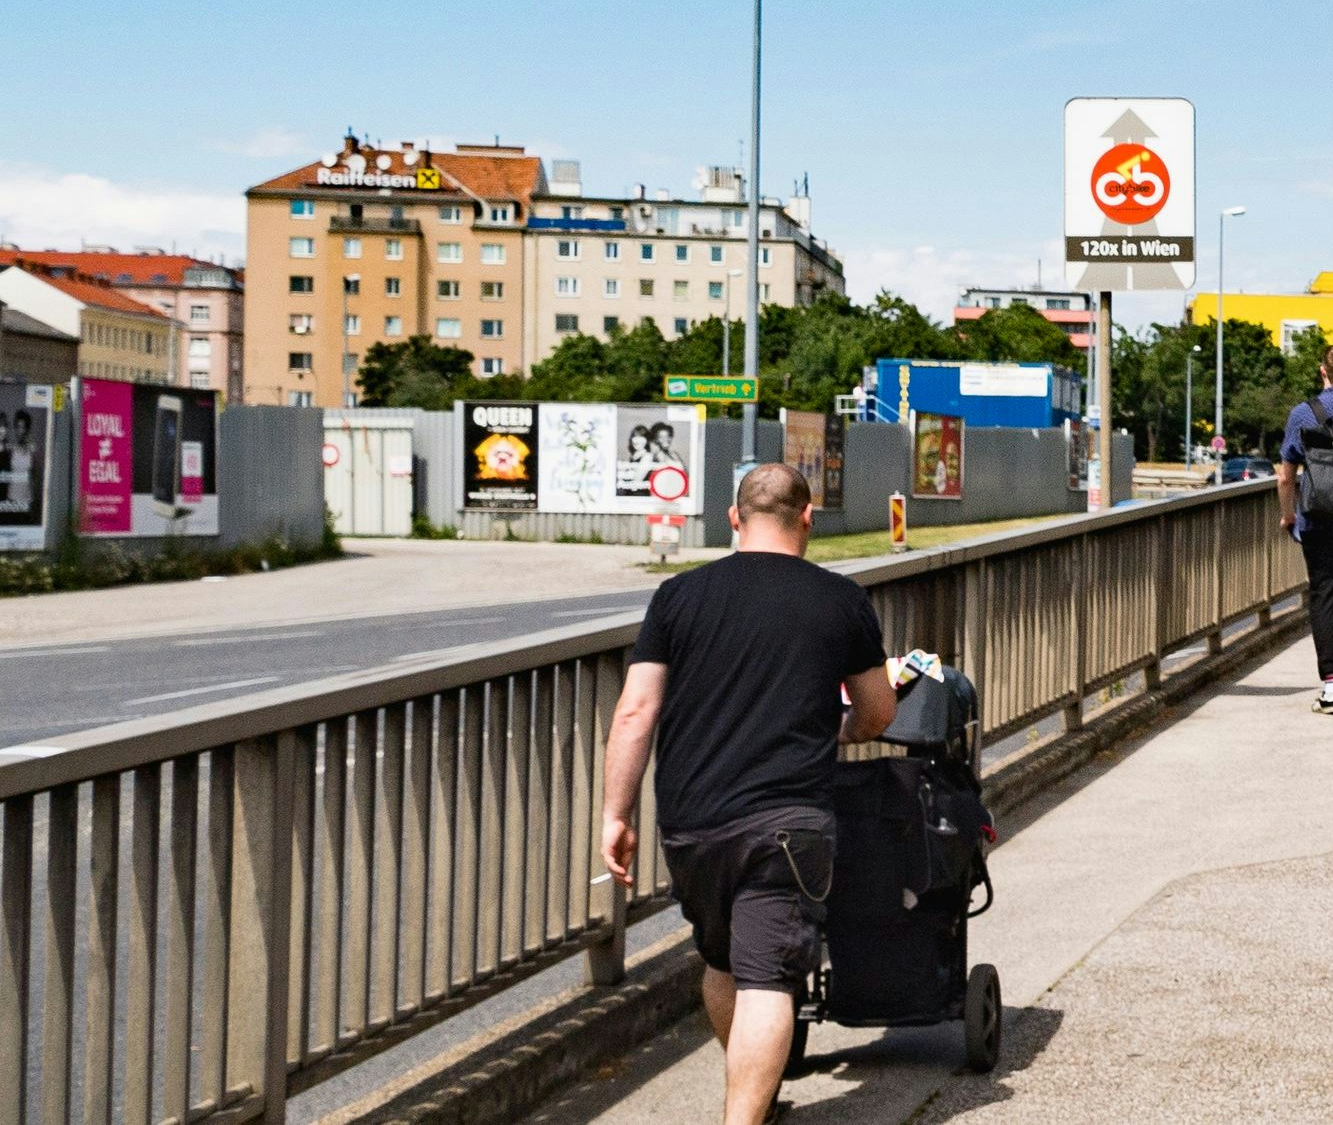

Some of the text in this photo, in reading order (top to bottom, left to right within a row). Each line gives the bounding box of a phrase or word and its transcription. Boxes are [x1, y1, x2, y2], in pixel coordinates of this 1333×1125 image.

[317, 167, 416, 188] Raiffeisen
[1081, 239, 1180, 256] 120x in Wien
[87, 413, 125, 438] LOYAL
[472, 406, 533, 427] QUEEN
[88, 460, 122, 483] EGAL
